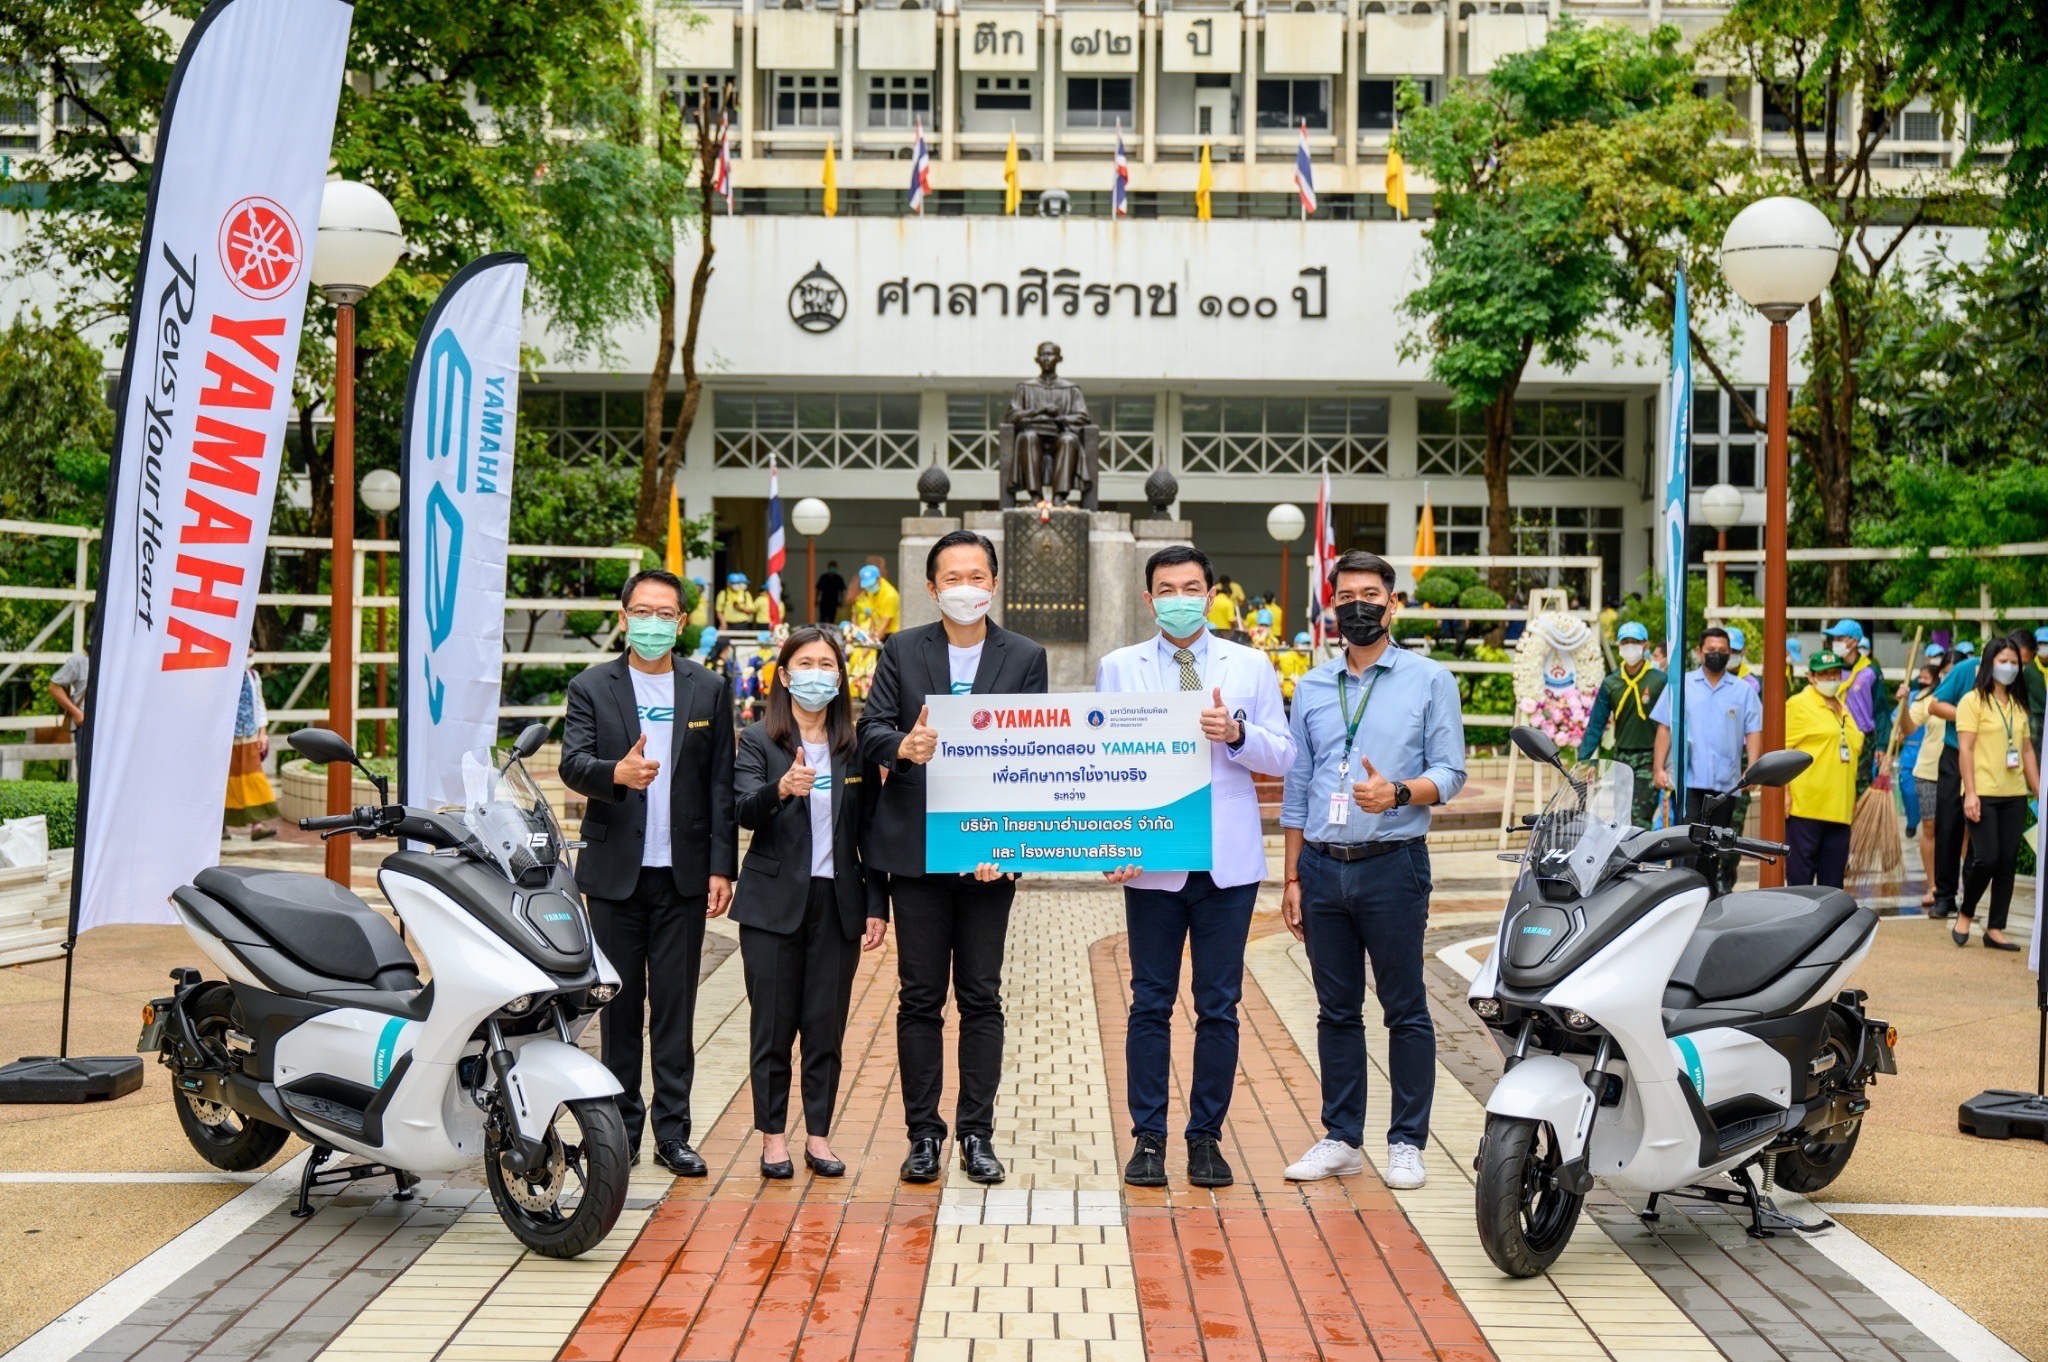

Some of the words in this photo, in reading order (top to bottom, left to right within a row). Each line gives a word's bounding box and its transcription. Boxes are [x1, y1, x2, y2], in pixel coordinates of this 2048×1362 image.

[973, 20, 1025, 56] ตึก
[1070, 28, 1132, 56] ๗๒
[1186, 18, 1213, 57] ปี
[877, 267, 1178, 317] ศาลาศิริราช
[1198, 295, 1278, 318] ๑๐๐
[1291, 266, 1328, 318] ปี
[476, 376, 505, 495] YAMAHA
[161, 314, 287, 672] YAMAHA
[994, 708, 1072, 729] YAMAHA
[942, 738, 1096, 757] โครงการร่วมมือทดสอบ
[1101, 741, 1167, 755] YAMAHA
[1172, 741, 1197, 755] E01
[992, 764, 1148, 783] เพื่อศึกษาการใช้งานจริง
[1054, 788, 1086, 801] ระหว่าง
[960, 817, 999, 832] บริษัท
[1002, 815, 1133, 832] ไทยยามาฮ่ามอเตอร์
[1138, 815, 1175, 831] จำกัด
[525, 832, 549, 848] 15
[992, 847, 1015, 859] และ
[1020, 843, 1143, 859] โรงพยาบาลศิริราช
[1540, 848, 1577, 864] 14
[543, 912, 573, 922] YAMAHA
[1523, 926, 1553, 937] YAMAHA
[377, 1048, 387, 1082] YAMAHA
